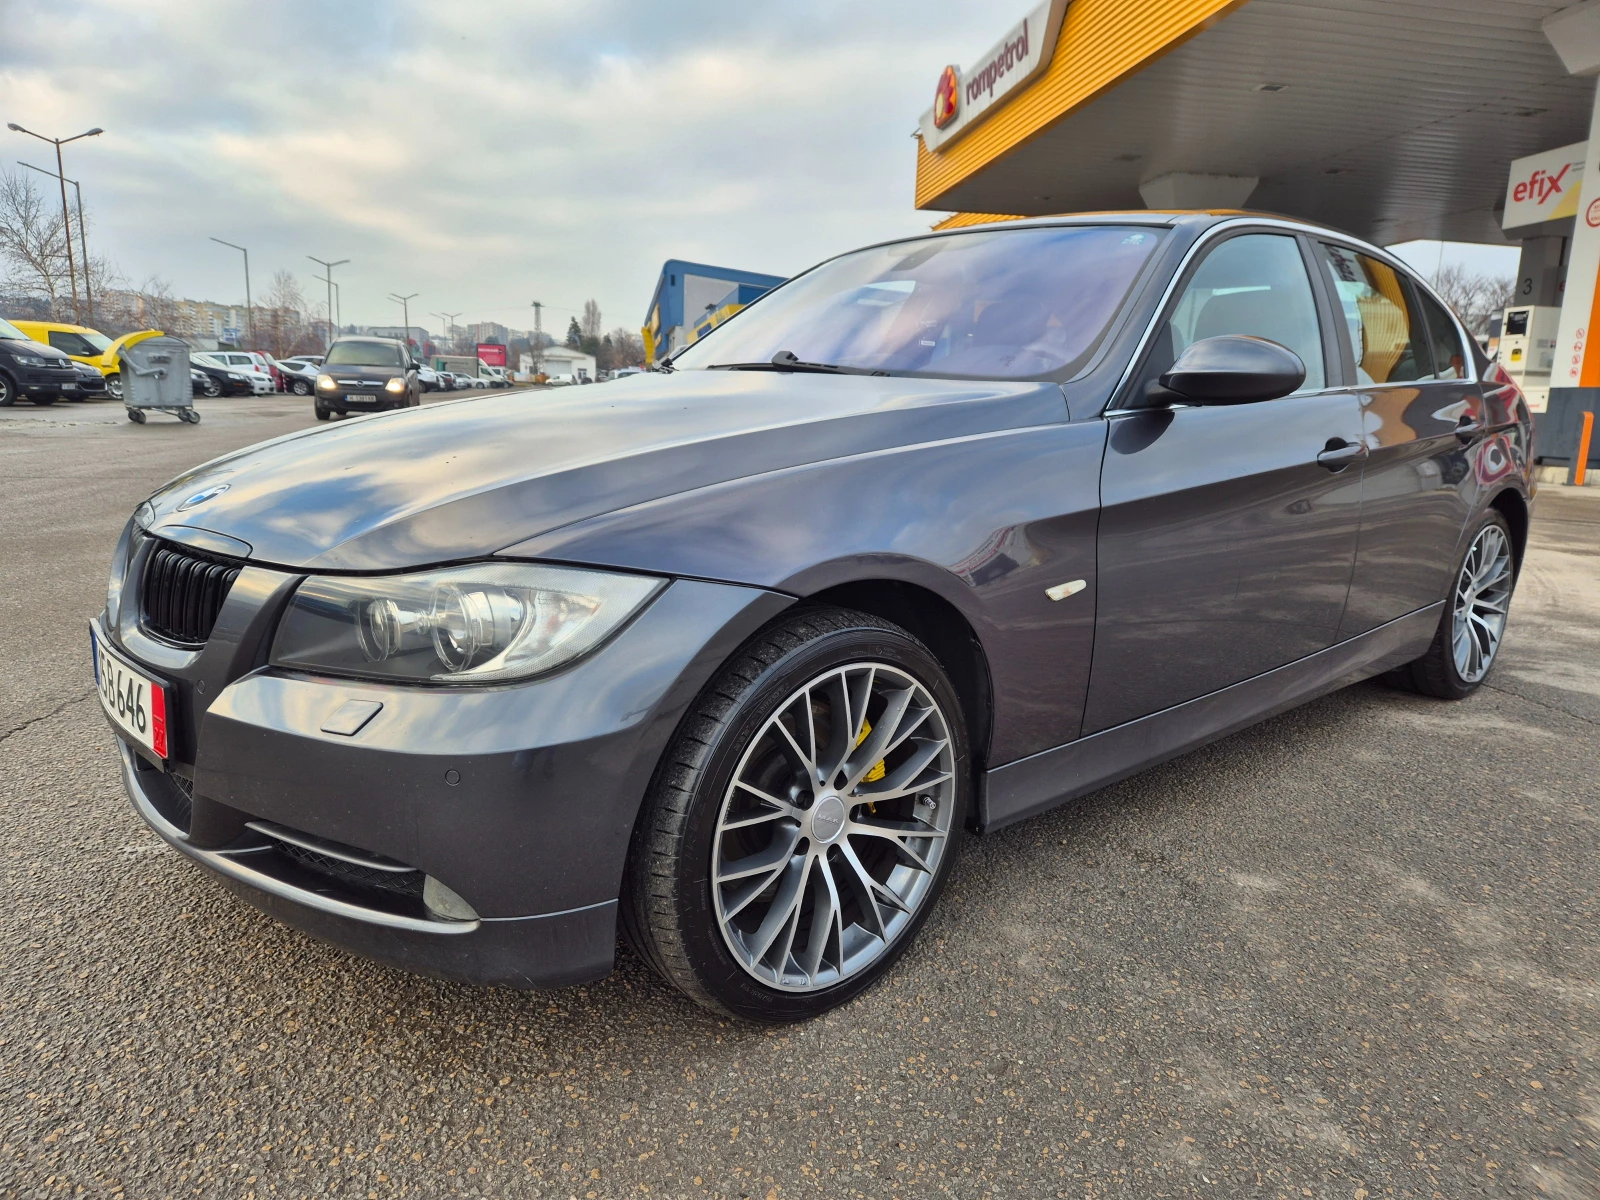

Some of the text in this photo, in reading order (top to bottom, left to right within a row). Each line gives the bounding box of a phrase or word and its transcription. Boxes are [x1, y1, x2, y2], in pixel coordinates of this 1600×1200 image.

[965, 18, 1029, 106] rompetrol
[1513, 162, 1572, 206] efix
[1522, 277, 1533, 295] 3
